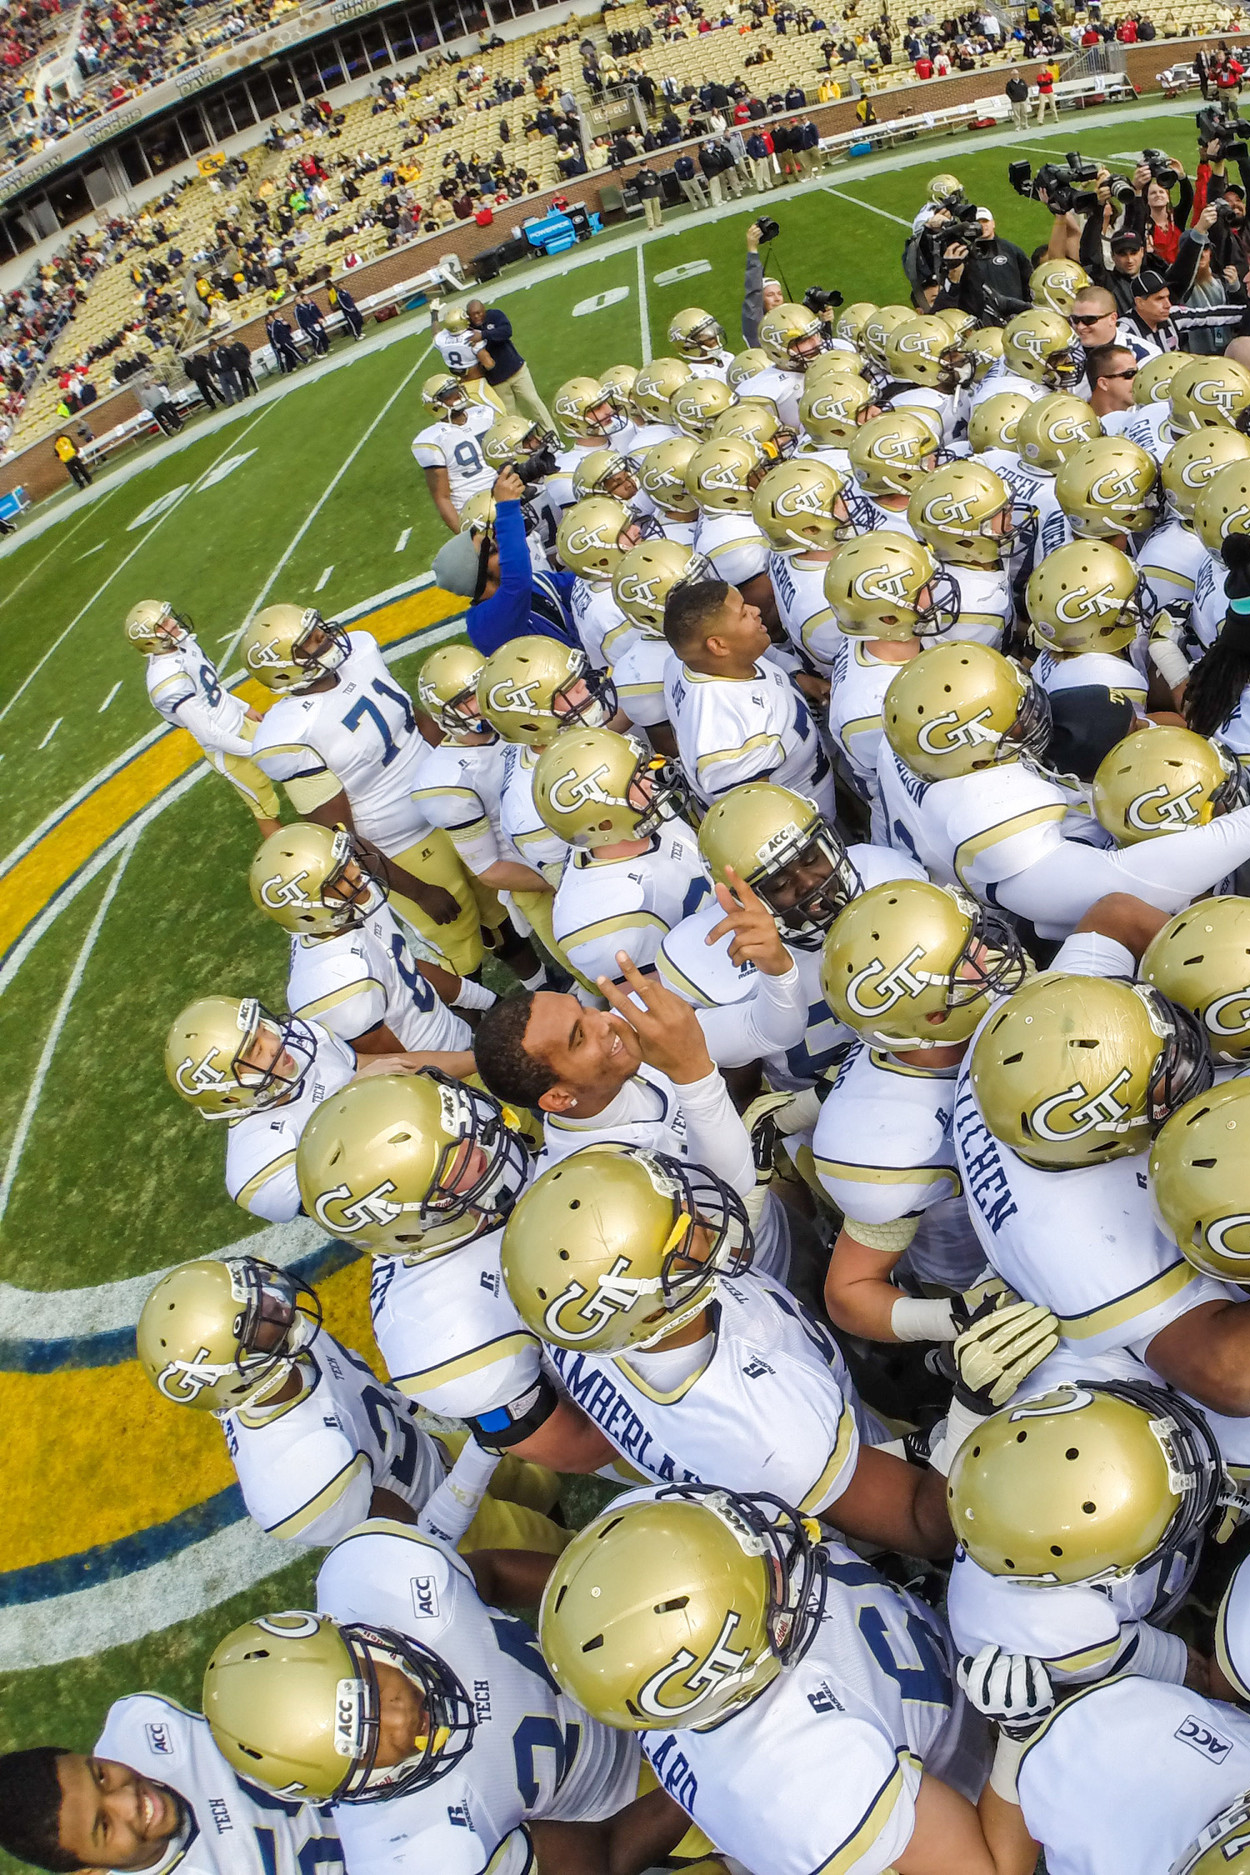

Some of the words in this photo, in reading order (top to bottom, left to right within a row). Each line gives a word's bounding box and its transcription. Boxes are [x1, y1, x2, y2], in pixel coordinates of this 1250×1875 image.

[334, 1, 379, 23] PUND
[176, 65, 208, 86] BOBBY
[180, 67, 222, 97] DAVIS
[88, 109, 141, 146] MORRIS
[1047, 272, 1078, 296] GT
[761, 325, 788, 346] GT
[900, 333, 937, 354] GT
[1012, 331, 1051, 354] GT
[637, 378, 664, 397] GT
[1193, 379, 1243, 410] GT
[556, 395, 583, 420] GT
[677, 398, 709, 419] GT
[812, 396, 853, 420] GT
[1049, 417, 1091, 444] GT
[487, 438, 510, 460] GT
[873, 432, 920, 460] GT
[701, 463, 743, 491] GT
[995, 465, 1043, 502] GREEN
[1090, 469, 1142, 505] GT
[776, 482, 825, 518] GT
[925, 493, 978, 526] GT
[567, 525, 608, 555] GT
[617, 574, 661, 603] GT
[855, 564, 914, 600] GT
[129, 617, 151, 640] GT
[248, 637, 281, 670] GT
[342, 677, 418, 768] 71
[917, 707, 994, 756] GT
[550, 765, 611, 814] GT
[1127, 783, 1203, 831] GT
[671, 840, 684, 862] TECH
[767, 829, 791, 854] ACC
[261, 870, 309, 910] GT
[846, 943, 929, 1019] GT
[240, 1002, 250, 1022] ACC
[174, 1046, 225, 1096] GT
[312, 1082, 326, 1104] TECH
[443, 1094, 456, 1119] ACC
[1029, 1065, 1134, 1143] GT
[315, 1178, 399, 1234] GT
[544, 1254, 634, 1343] GT
[720, 1277, 749, 1305] TECH
[157, 1346, 219, 1403] GT
[327, 1355, 345, 1381] TECH
[254, 1376, 279, 1400] ADAMS
[417, 1579, 435, 1615] ACC
[638, 1609, 751, 1719] GT
[475, 1679, 492, 1725] TECH
[821, 1680, 846, 1713] RUSSELL
[338, 1699, 354, 1738] ACC
[151, 1723, 172, 1752] ACC
[1181, 1719, 1229, 1755] ACC
[209, 1798, 233, 1835] TECH
[463, 1798, 477, 1832] RUSSELL
